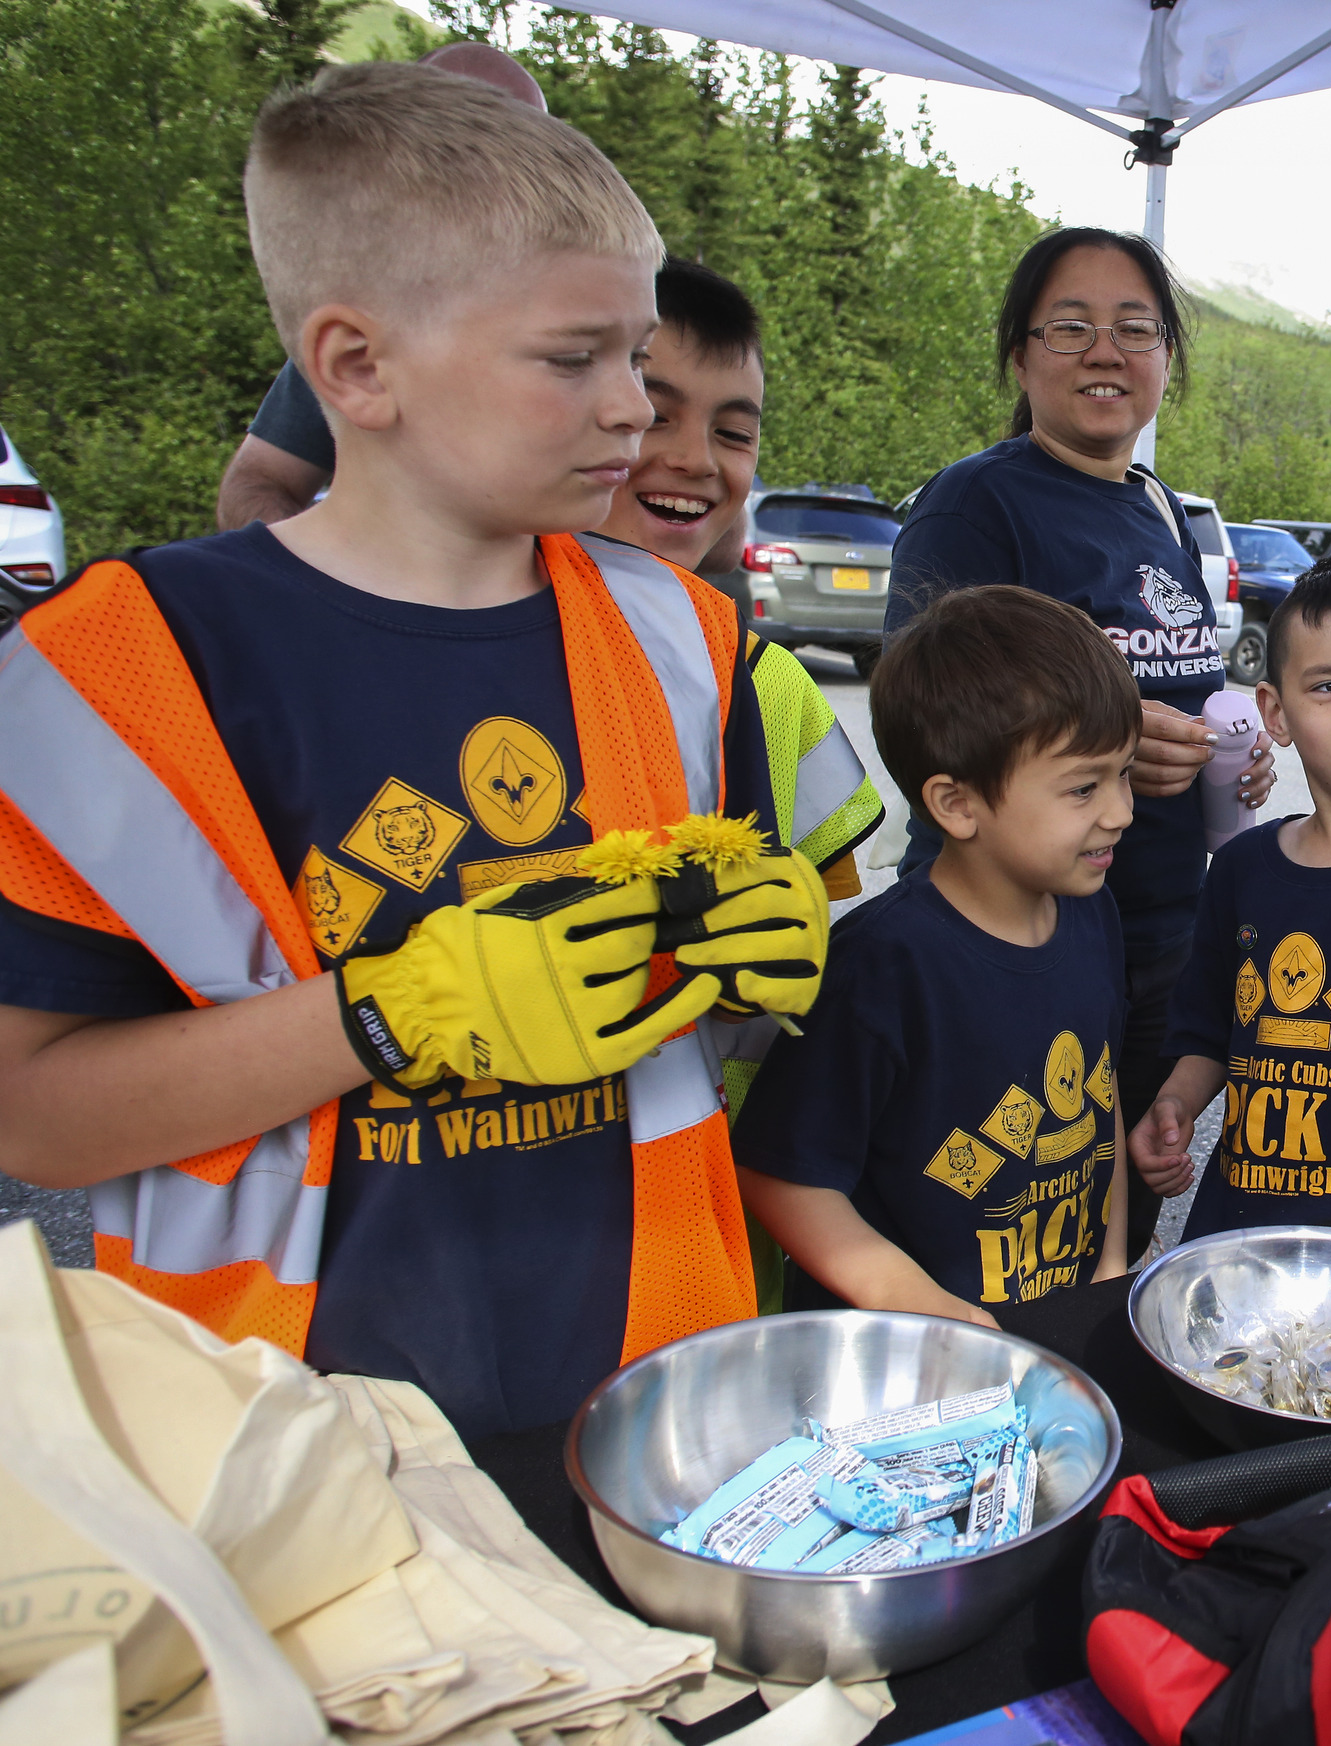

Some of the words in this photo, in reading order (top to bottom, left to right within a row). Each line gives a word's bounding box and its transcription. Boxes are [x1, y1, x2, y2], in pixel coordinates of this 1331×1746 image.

[1102, 625, 1218, 657] GONZA
[394, 853, 433, 869] TIGER
[308, 913, 350, 928] BOBCAT
[358, 1007, 388, 1045] GRIP
[378, 1042, 408, 1070] FIRM
[1011, 1133, 1032, 1145] TIGER
[950, 1169, 982, 1179] BOBCAT
[1026, 1169, 1079, 1206] Arctic
